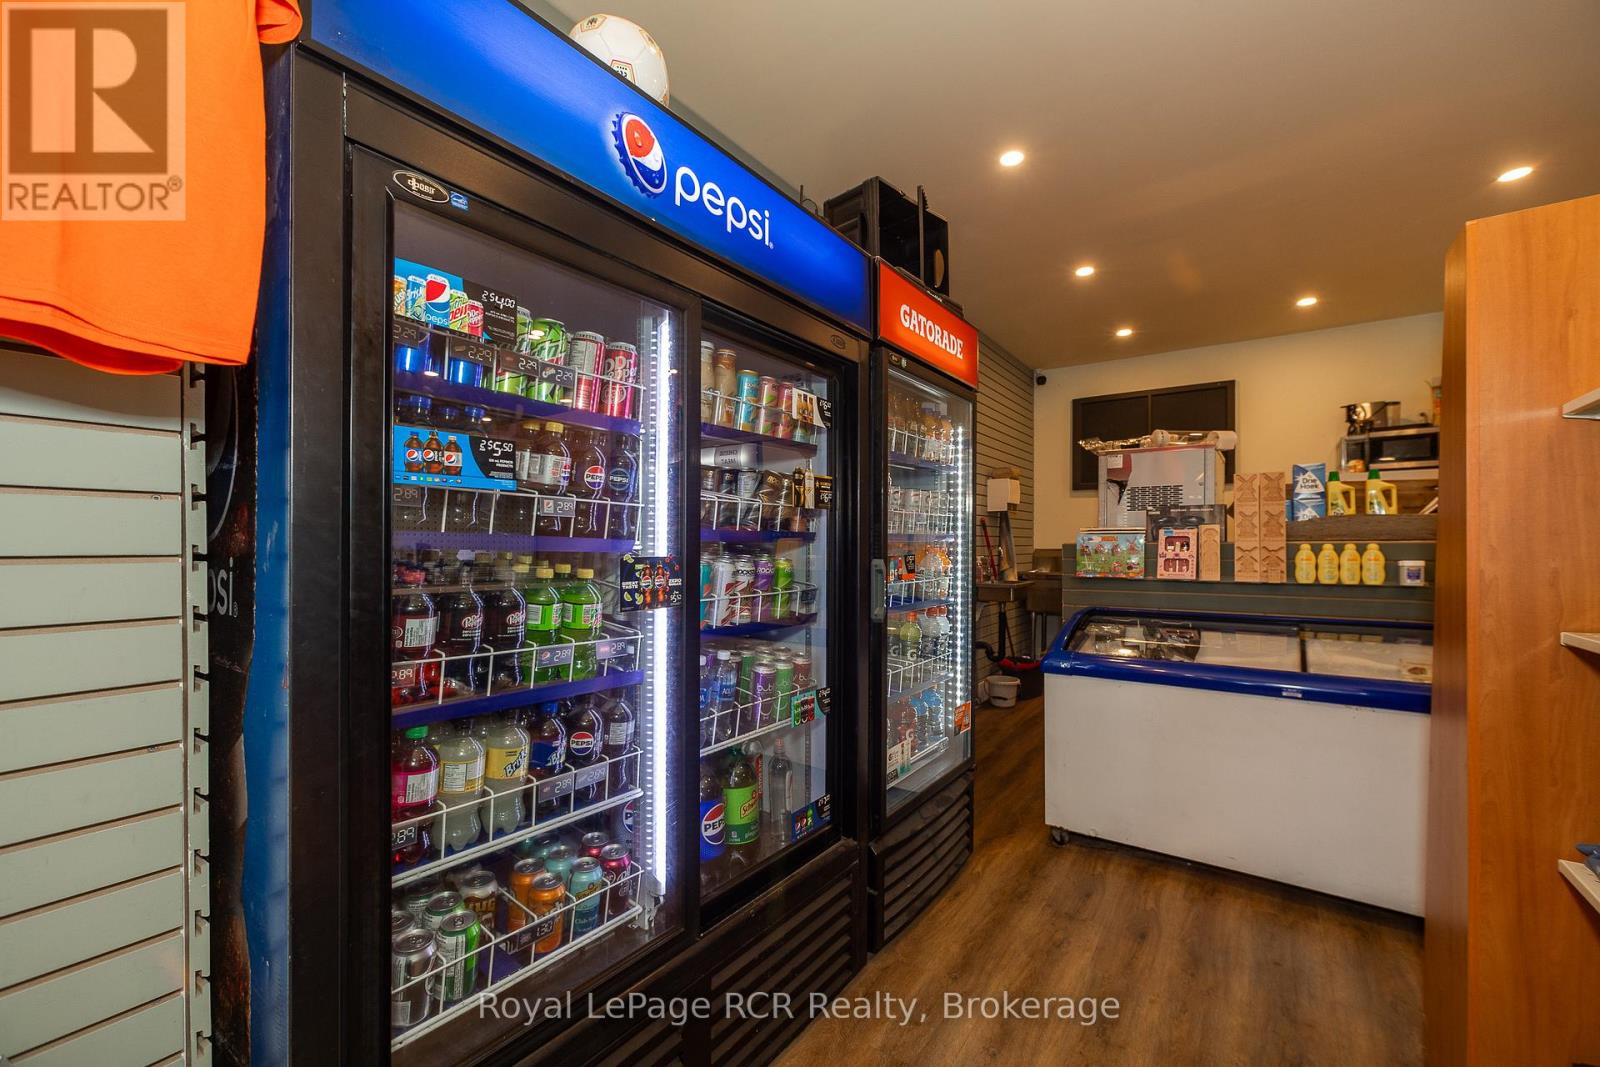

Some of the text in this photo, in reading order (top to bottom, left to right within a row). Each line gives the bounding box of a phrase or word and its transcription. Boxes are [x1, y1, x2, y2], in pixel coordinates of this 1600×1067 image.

[900, 303, 964, 360] GATORADE
[468, 346, 492, 362] 2.29
[518, 357, 537, 370] 2.29
[556, 501, 574, 513] 2.89
[611, 641, 627, 654] 2.89
[553, 649, 571, 662] 2.89
[554, 778, 572, 794] 2.89
